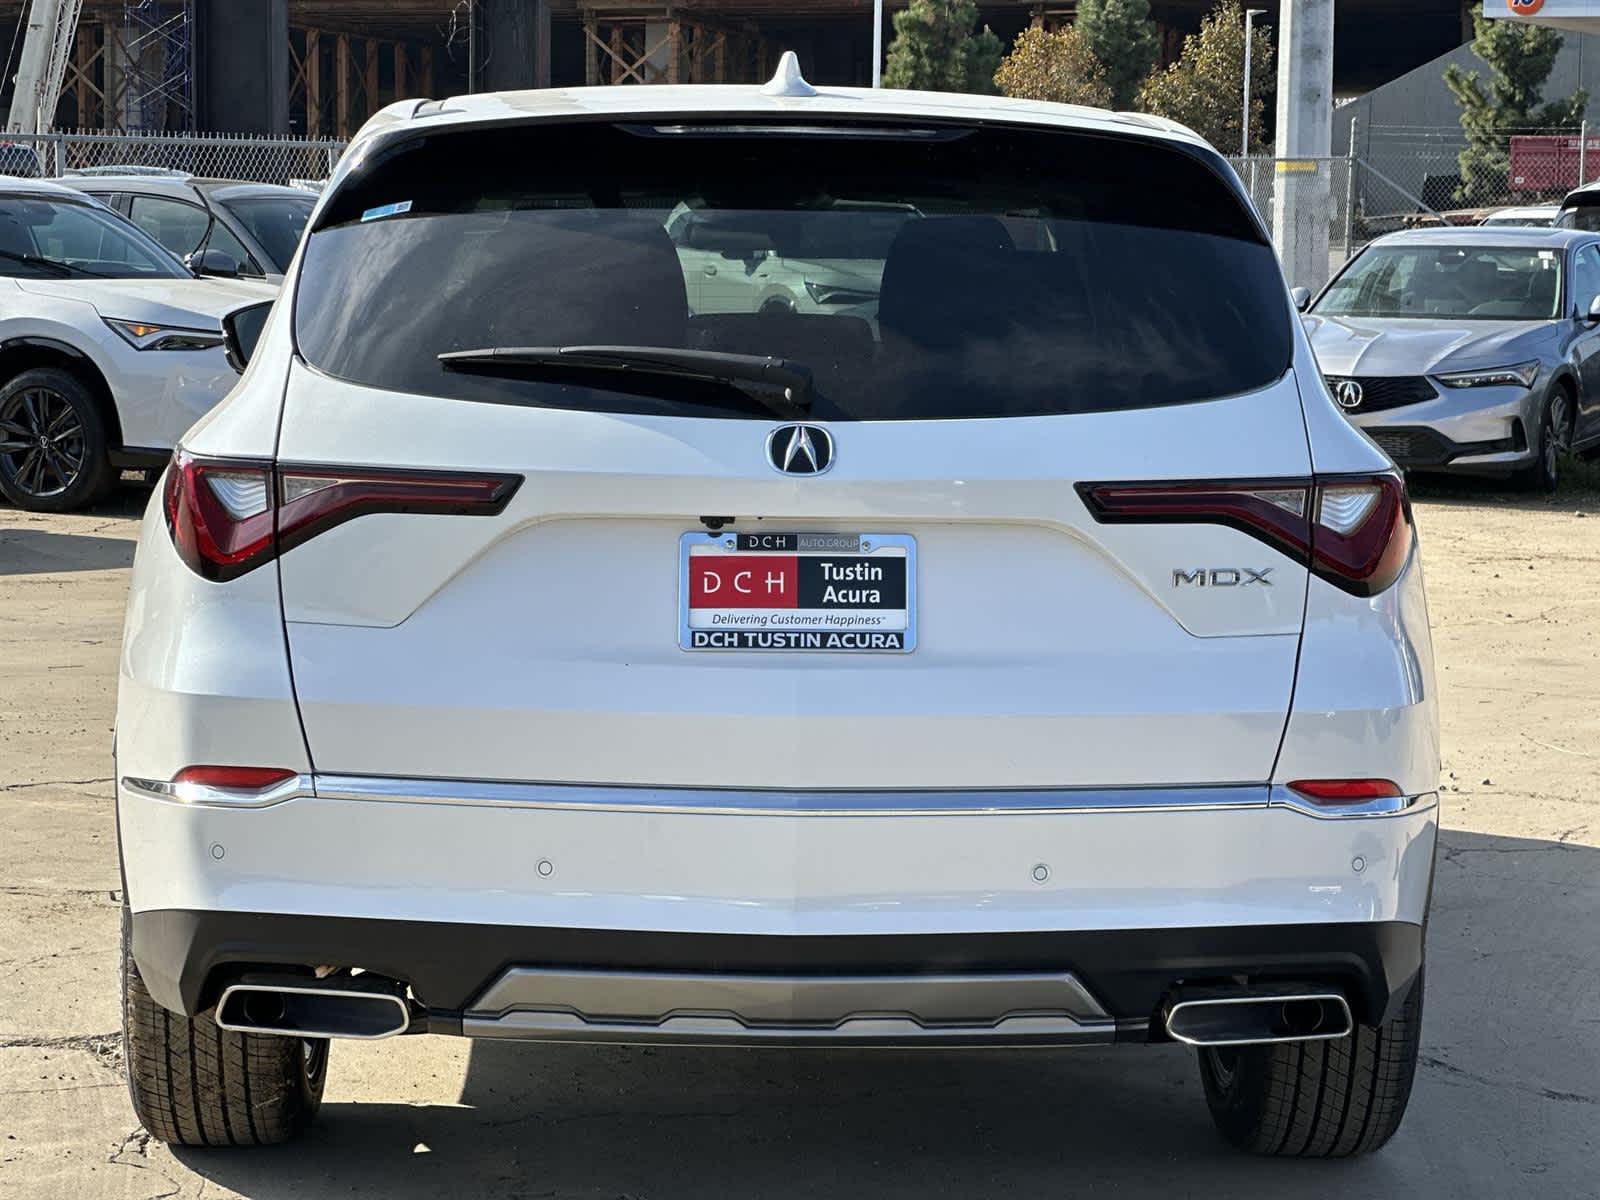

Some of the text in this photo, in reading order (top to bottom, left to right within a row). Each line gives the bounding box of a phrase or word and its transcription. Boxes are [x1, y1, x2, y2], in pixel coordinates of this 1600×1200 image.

[749, 535, 859, 548] DCH AUTO GROUP
[820, 563, 882, 581] Tustin
[1172, 568, 1274, 587] MDX
[703, 571, 784, 593] DCH
[822, 586, 881, 603] Acura
[712, 613, 767, 627] Delivering
[770, 614, 823, 625] Customer
[694, 632, 900, 649] DCH TUSTIN ACURA
